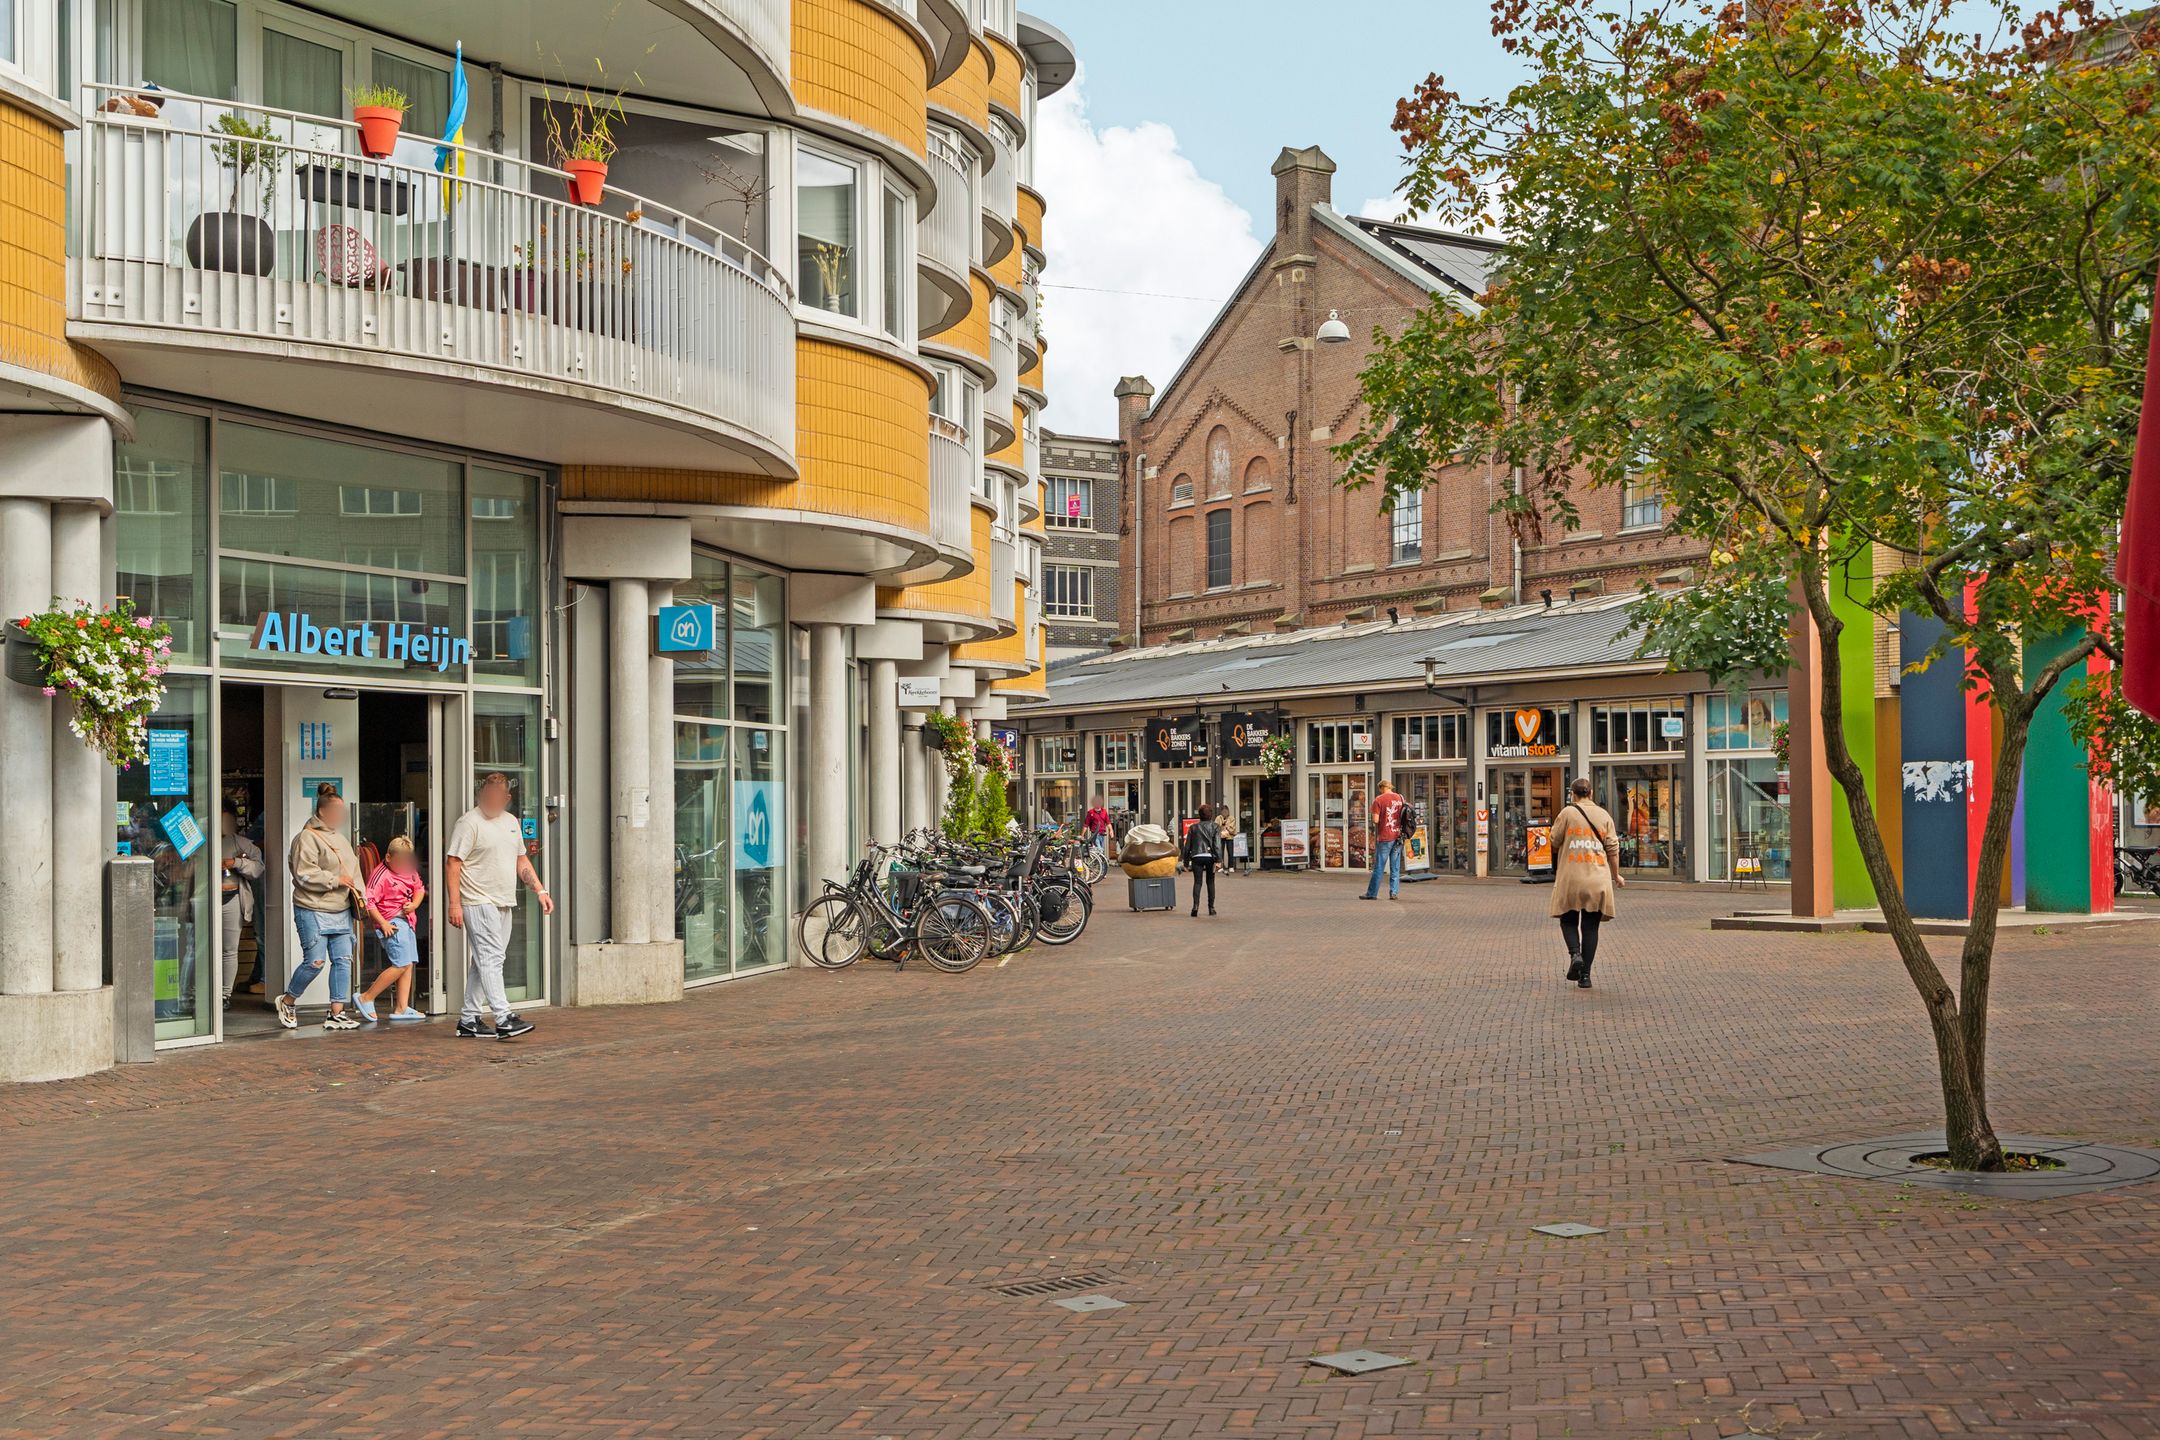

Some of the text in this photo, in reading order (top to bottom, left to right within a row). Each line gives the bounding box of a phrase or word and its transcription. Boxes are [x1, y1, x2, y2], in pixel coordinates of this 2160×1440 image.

[257, 611, 469, 673] Albert Heijn
[1247, 729, 1269, 737] BAKKERS
[1005, 733, 1015, 747] P
[1171, 740, 1187, 748] ZONEN
[1247, 736, 1264, 744] ZONEN
[1491, 743, 1556, 757] vitaminstore
